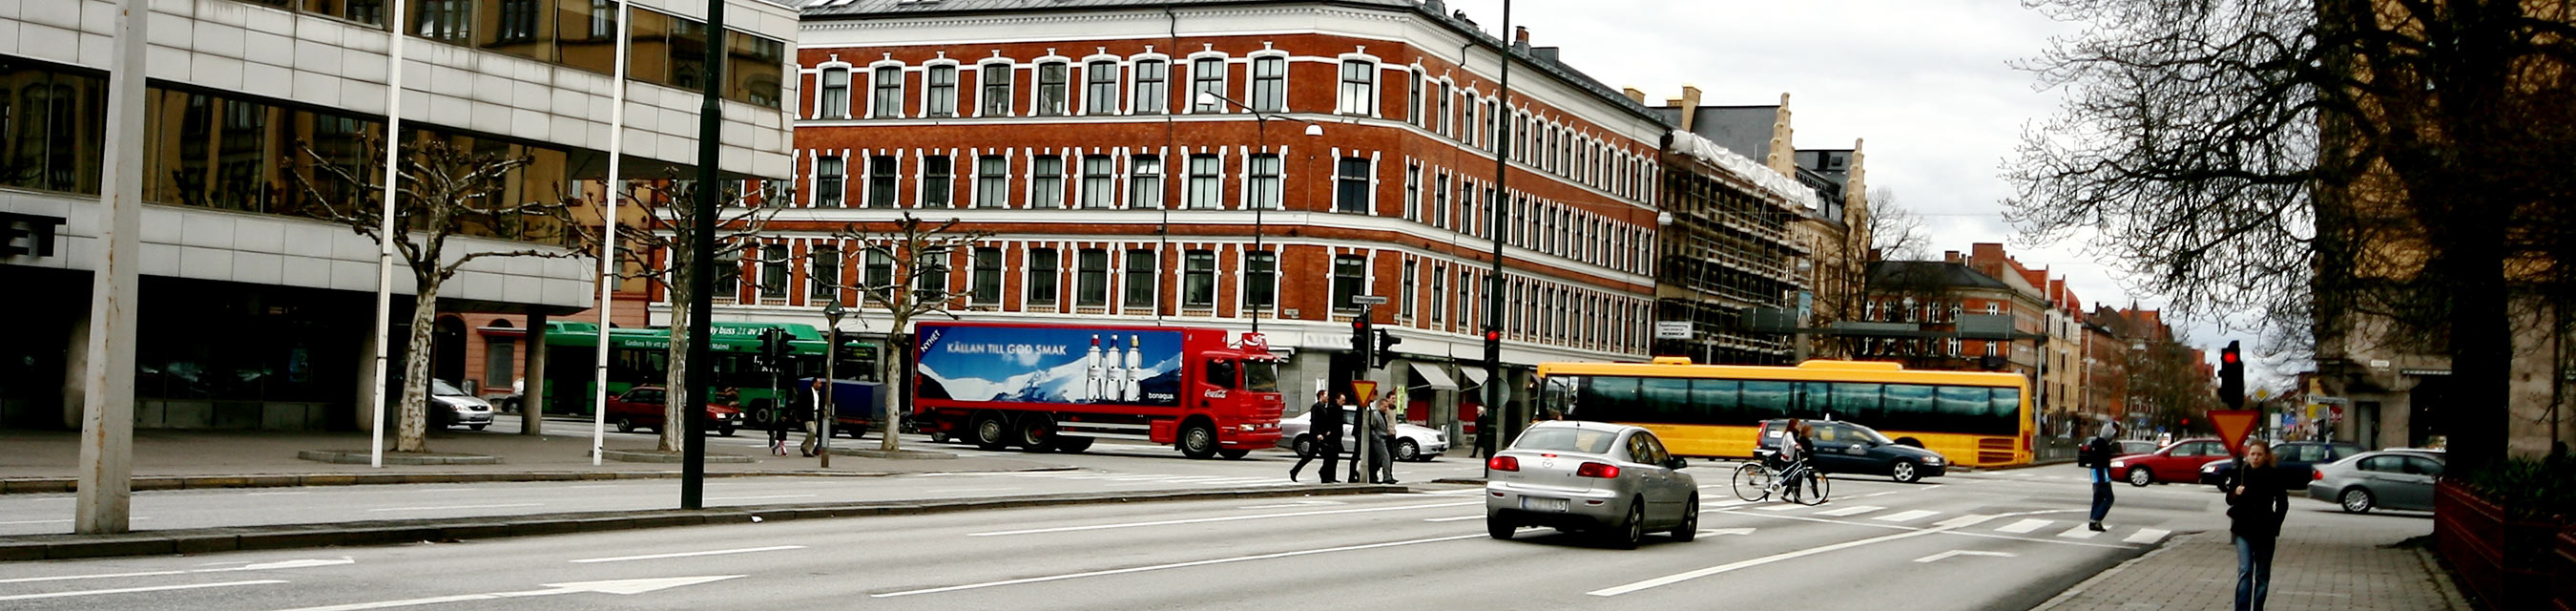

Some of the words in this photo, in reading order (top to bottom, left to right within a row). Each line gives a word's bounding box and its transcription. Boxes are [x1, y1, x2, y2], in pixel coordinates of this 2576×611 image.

[718, 326, 736, 335] buss
[920, 329, 941, 352] NYHET
[987, 344, 1004, 354] TILL
[1007, 344, 1033, 354] GOD
[1035, 344, 1068, 356] SMAK
